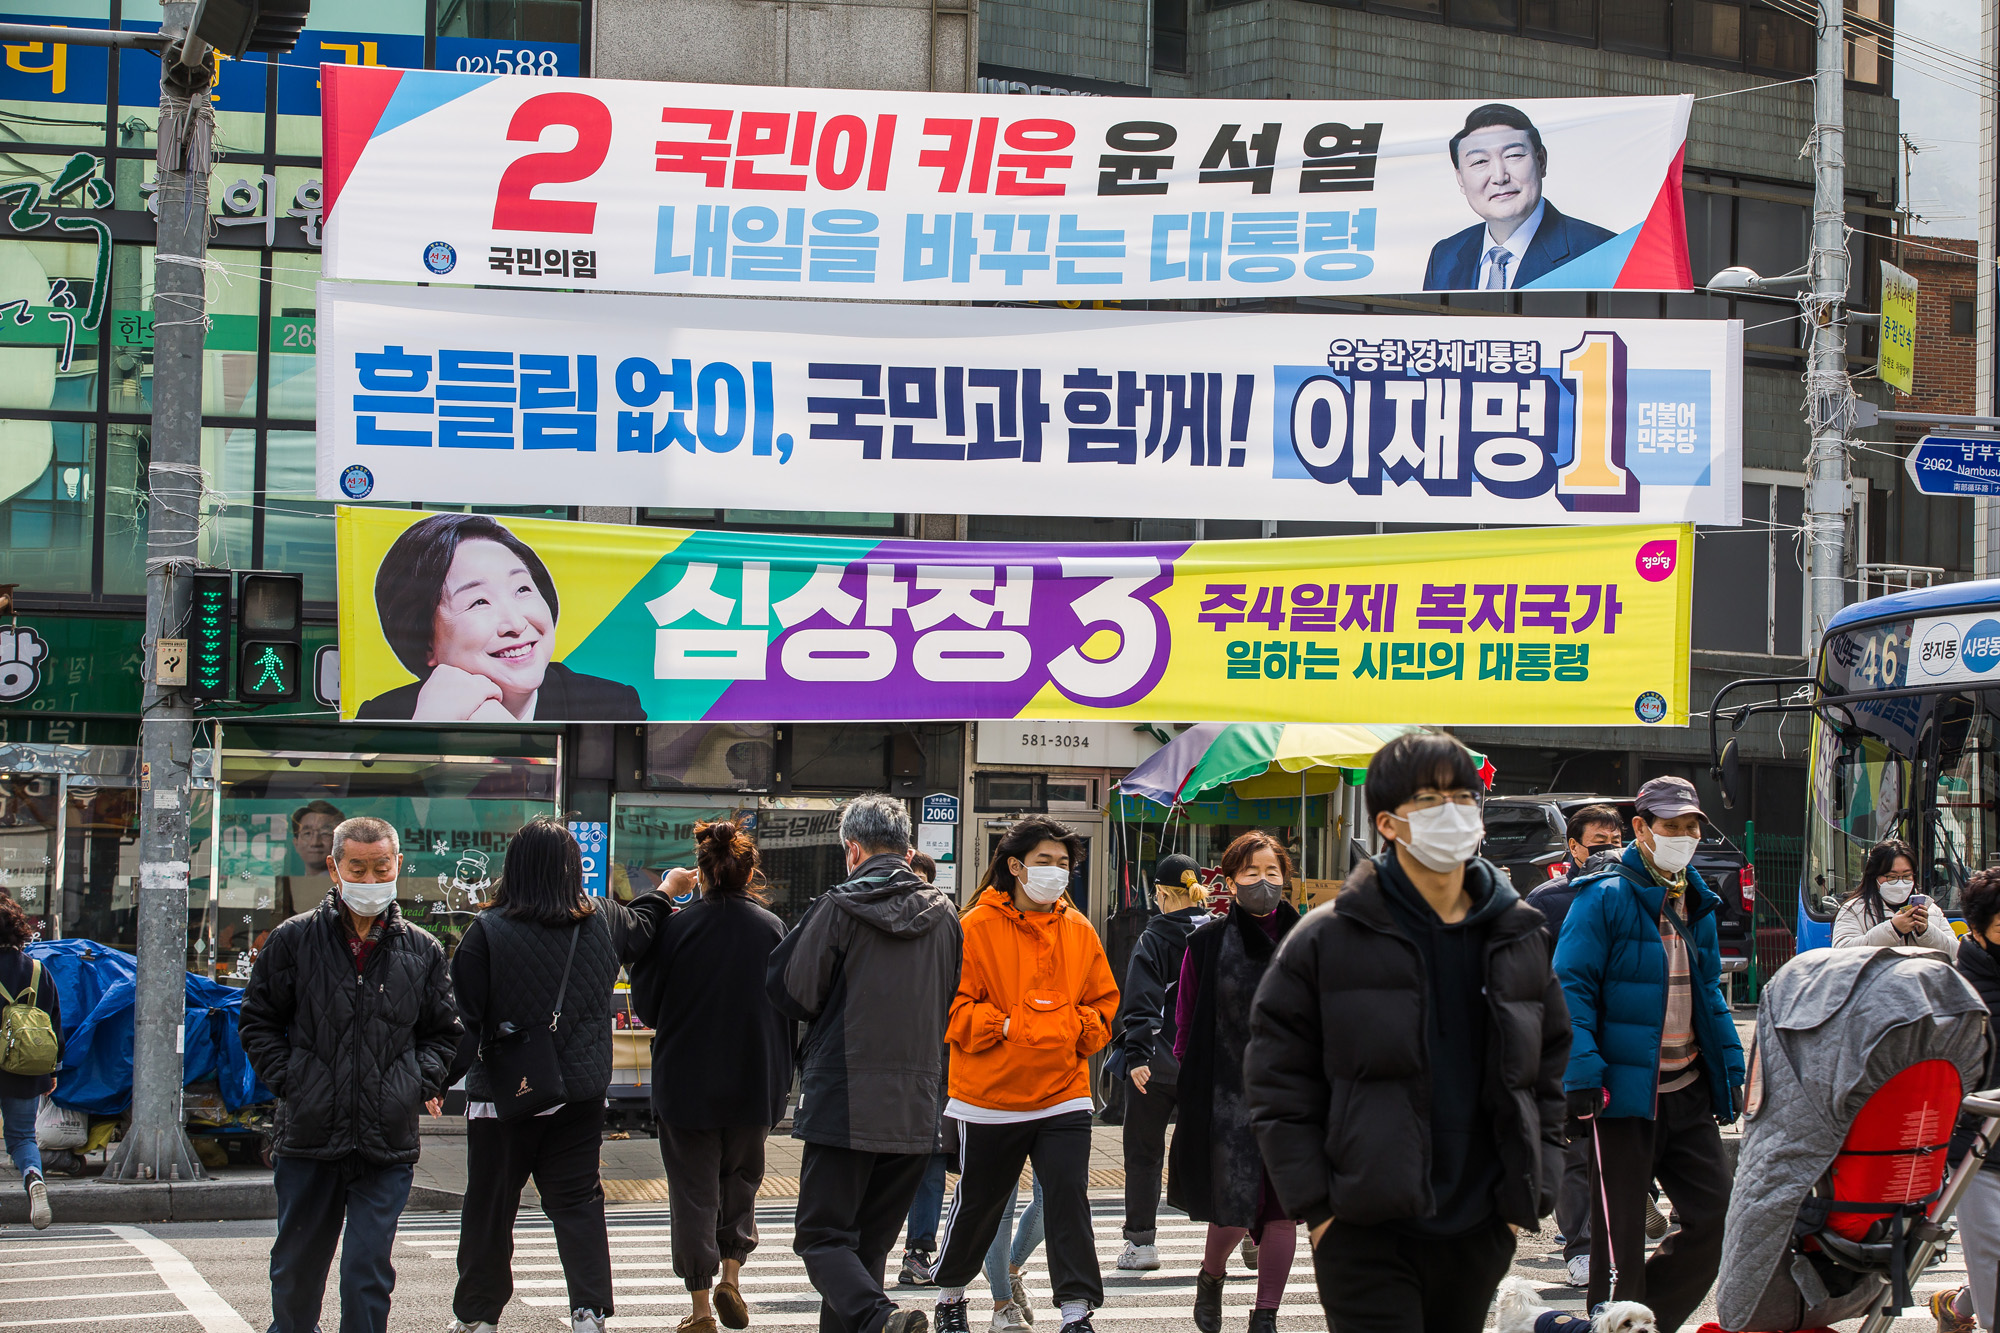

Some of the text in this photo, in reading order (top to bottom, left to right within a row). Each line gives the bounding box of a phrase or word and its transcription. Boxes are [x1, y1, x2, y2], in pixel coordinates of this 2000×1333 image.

[491, 92, 613, 235] 2
[655, 106, 898, 192] 국민이
[917, 116, 1077, 196] 키운
[488, 246, 598, 280] 국민의힘
[654, 204, 1378, 286] 내일을 바꾸는 대통령
[1883, 315, 1913, 352] 중점단속
[1328, 339, 1538, 375] 유능한 경제대통령
[352, 344, 1256, 468] 흔들림 없이, 국민과 함께!
[1292, 331, 1632, 498] 이재명 1
[1637, 401, 1697, 430] 더불어
[1637, 428, 1698, 454] 민주당
[1961, 442, 2000, 463] 남부
[1923, 456, 1953, 471] 2062
[1641, 555, 1672, 569] 정의당
[1197, 583, 1623, 635] 주4일제 복지국가
[643, 555, 1164, 700] 심상정 3
[1225, 640, 1590, 683] 일하는 시민의 대통령
[1861, 633, 1911, 686] 46
[1921, 639, 1958, 662] 장지동
[1021, 733, 1090, 748] 581-3034
[926, 807, 955, 821] 2060
